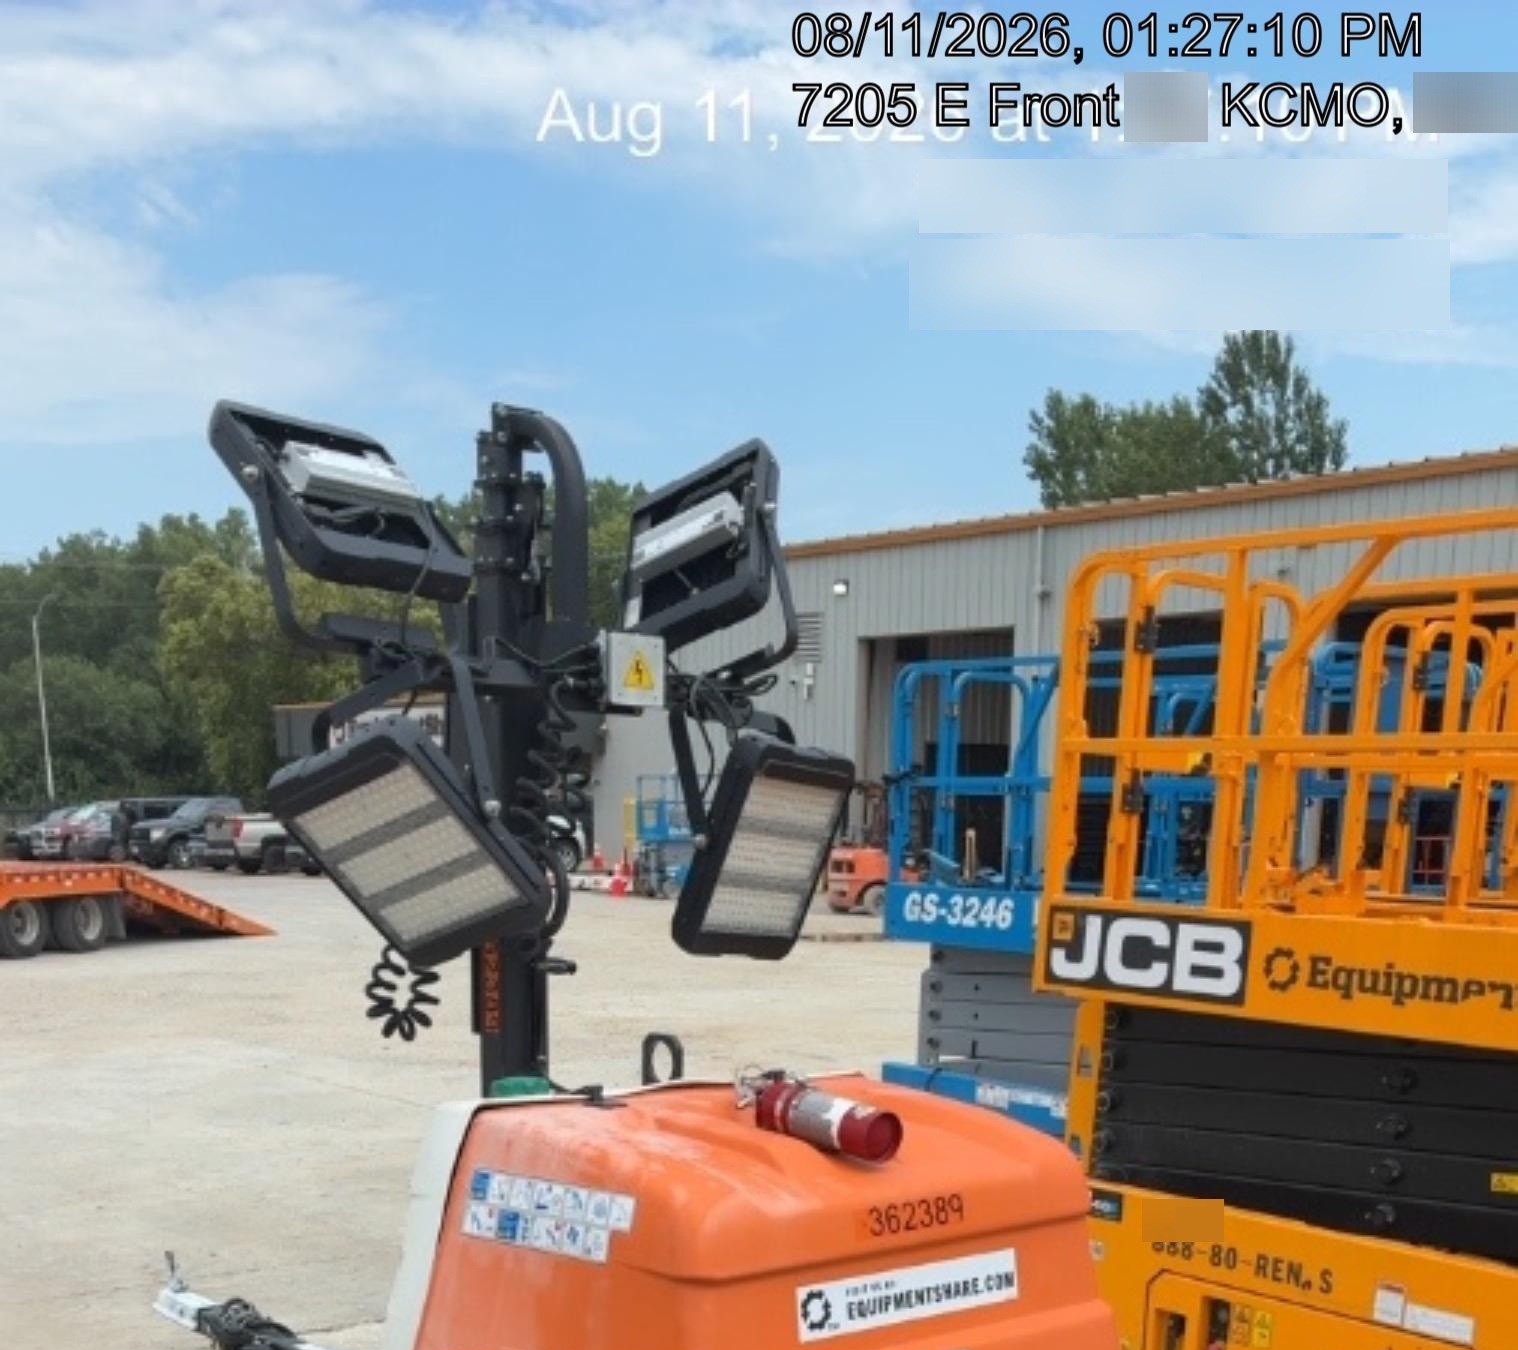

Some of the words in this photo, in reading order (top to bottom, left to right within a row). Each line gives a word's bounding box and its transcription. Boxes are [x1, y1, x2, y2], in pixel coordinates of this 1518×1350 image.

[904, 891, 1014, 931] GS-3246
[1051, 914, 1243, 997] JCB
[868, 1193, 965, 1237] 362389
